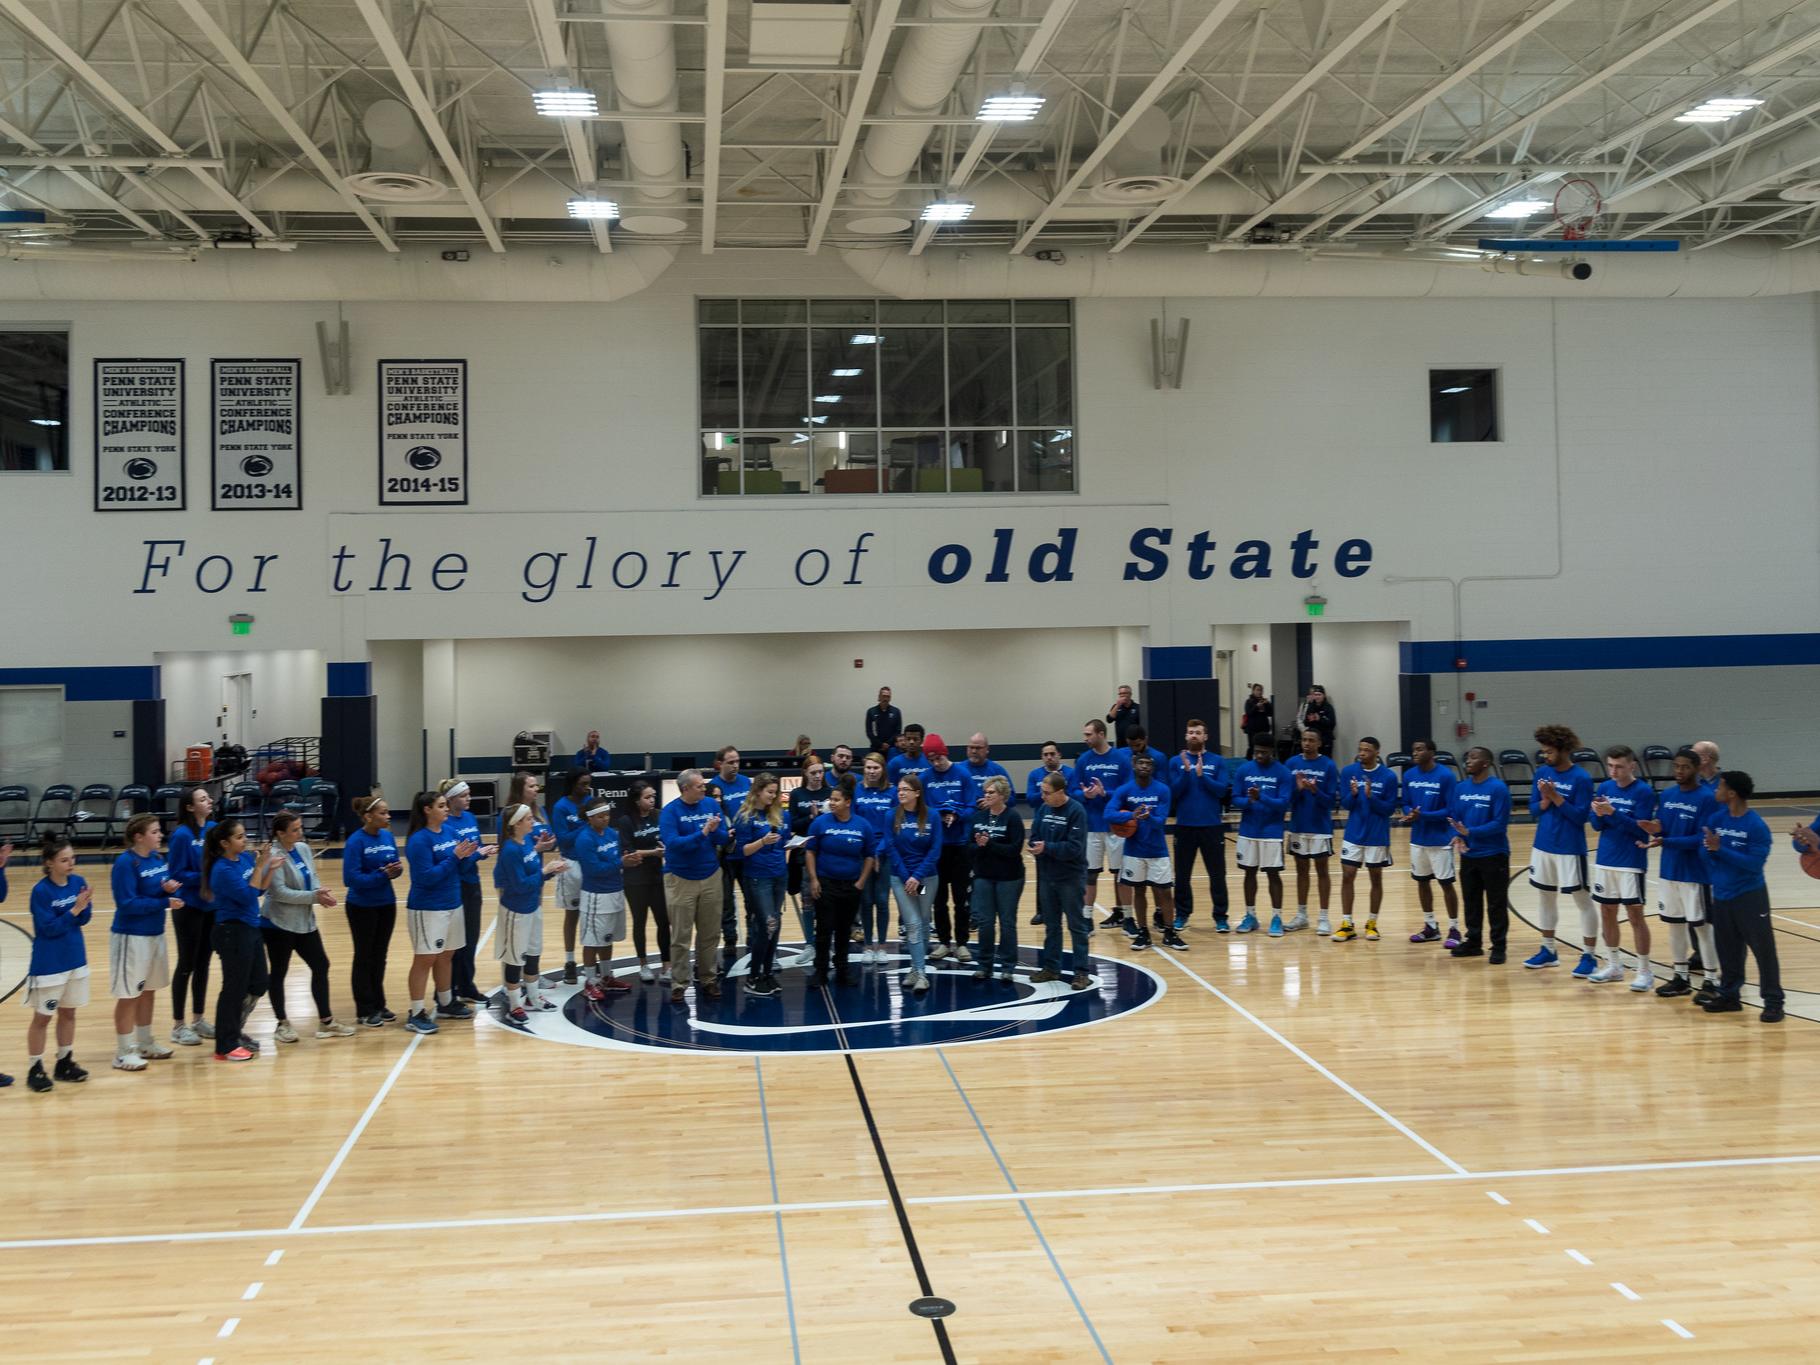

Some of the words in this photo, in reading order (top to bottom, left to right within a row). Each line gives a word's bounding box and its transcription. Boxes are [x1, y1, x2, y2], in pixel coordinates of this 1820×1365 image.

[103, 377, 135, 386] PENN
[139, 377, 176, 386] STATE
[220, 377, 252, 386] PENN
[255, 377, 292, 386] STATE
[386, 377, 419, 386] PENN
[422, 377, 459, 386] STATE
[103, 388, 176, 397] UNIVERSITY
[220, 388, 292, 397] UNIVERSITY
[387, 386, 459, 395] UNIVERSITY
[387, 403, 459, 412] CONFERENCE
[103, 409, 176, 418] CONFERENCE
[220, 409, 292, 418] CONFERENCE
[387, 412, 459, 426] CHAMPIONS
[103, 420, 176, 437] CHAMPIONS
[220, 420, 292, 435] CHAMPIONS
[387, 477, 460, 493] 2014-15
[103, 485, 177, 502] 2012-13
[221, 483, 293, 499] 2013-14
[133, 539, 279, 594] For
[332, 538, 468, 592] the
[522, 536, 748, 603] glory
[795, 532, 874, 587] of
[927, 527, 1079, 584] old
[1123, 526, 1374, 582] State
